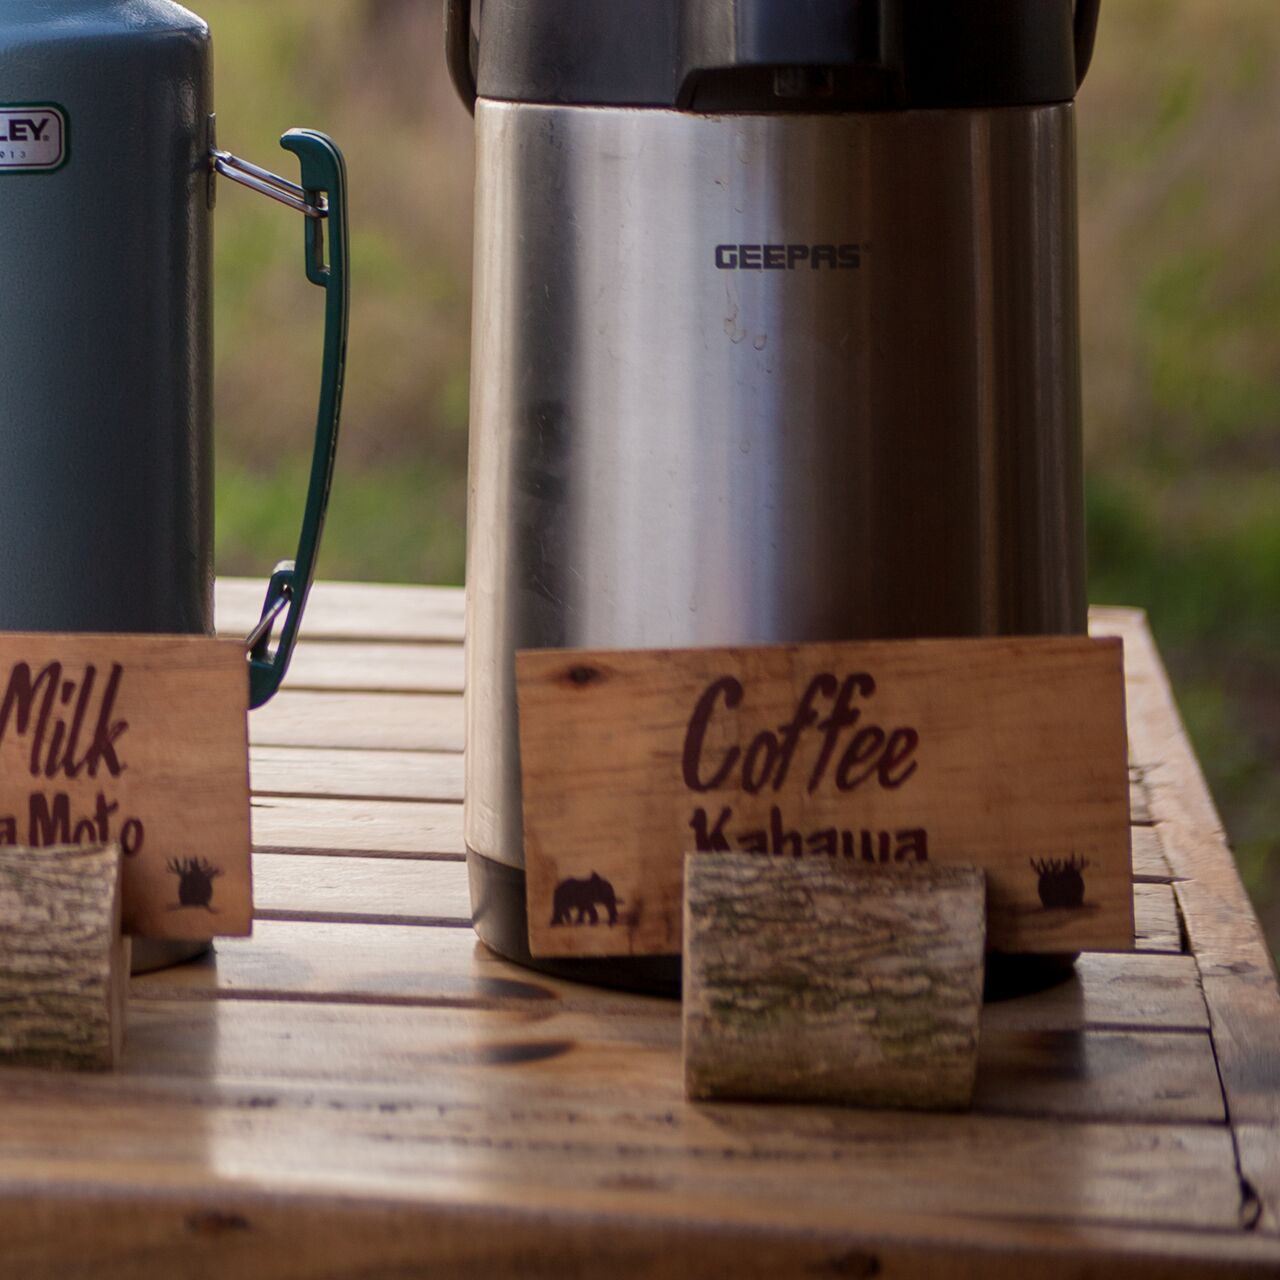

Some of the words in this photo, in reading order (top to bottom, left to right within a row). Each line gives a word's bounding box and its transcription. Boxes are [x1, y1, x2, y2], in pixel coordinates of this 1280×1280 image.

[714, 244, 861, 270] GEEPAS
[680, 671, 920, 796] Coffee
[28, 789, 145, 856] Moto
[687, 804, 929, 863] Kahawa
